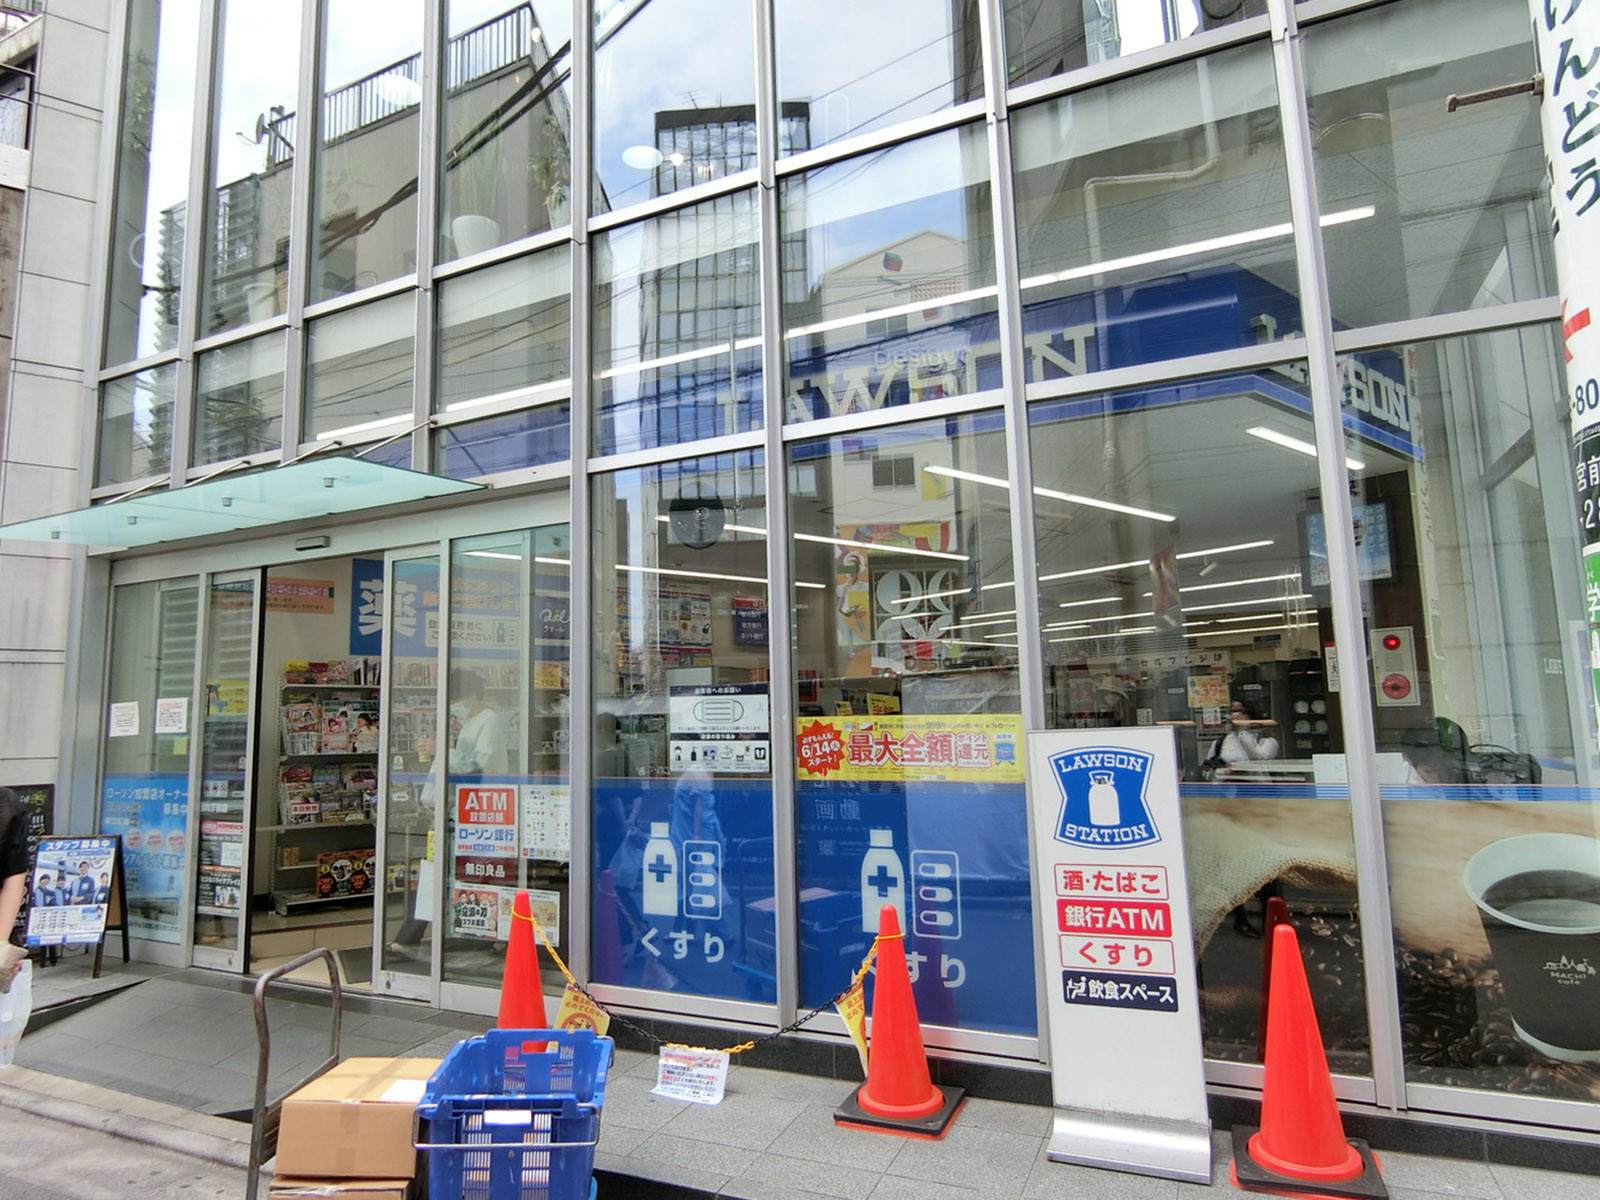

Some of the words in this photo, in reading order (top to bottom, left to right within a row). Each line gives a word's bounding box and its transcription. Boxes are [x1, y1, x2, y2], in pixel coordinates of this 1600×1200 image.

[1250, 313, 1411, 432] LSON
[357, 578, 418, 638] 薬
[431, 632, 492, 642] ご談ください
[848, 733, 954, 764] 最大全額
[957, 734, 988, 743] ポイント
[957, 743, 990, 760] 還元
[1057, 753, 1145, 773] LAWSON
[163, 802, 188, 815] 募集中
[465, 791, 508, 811] ATM
[470, 811, 504, 822] 設置店舗
[459, 828, 515, 842] ローソン銀行
[1064, 823, 1150, 843] STATION
[46, 839, 111, 851] スタッフ募集中
[465, 863, 506, 878] 無印良品
[1062, 870, 1161, 894] 酒・たばこ
[1065, 905, 1165, 931] 銀行ATM
[641, 927, 725, 963] くすり
[1078, 941, 1153, 967] くすり
[1550, 971, 1587, 980] MACHI
[1088, 979, 1174, 1004] 飲食スペース
